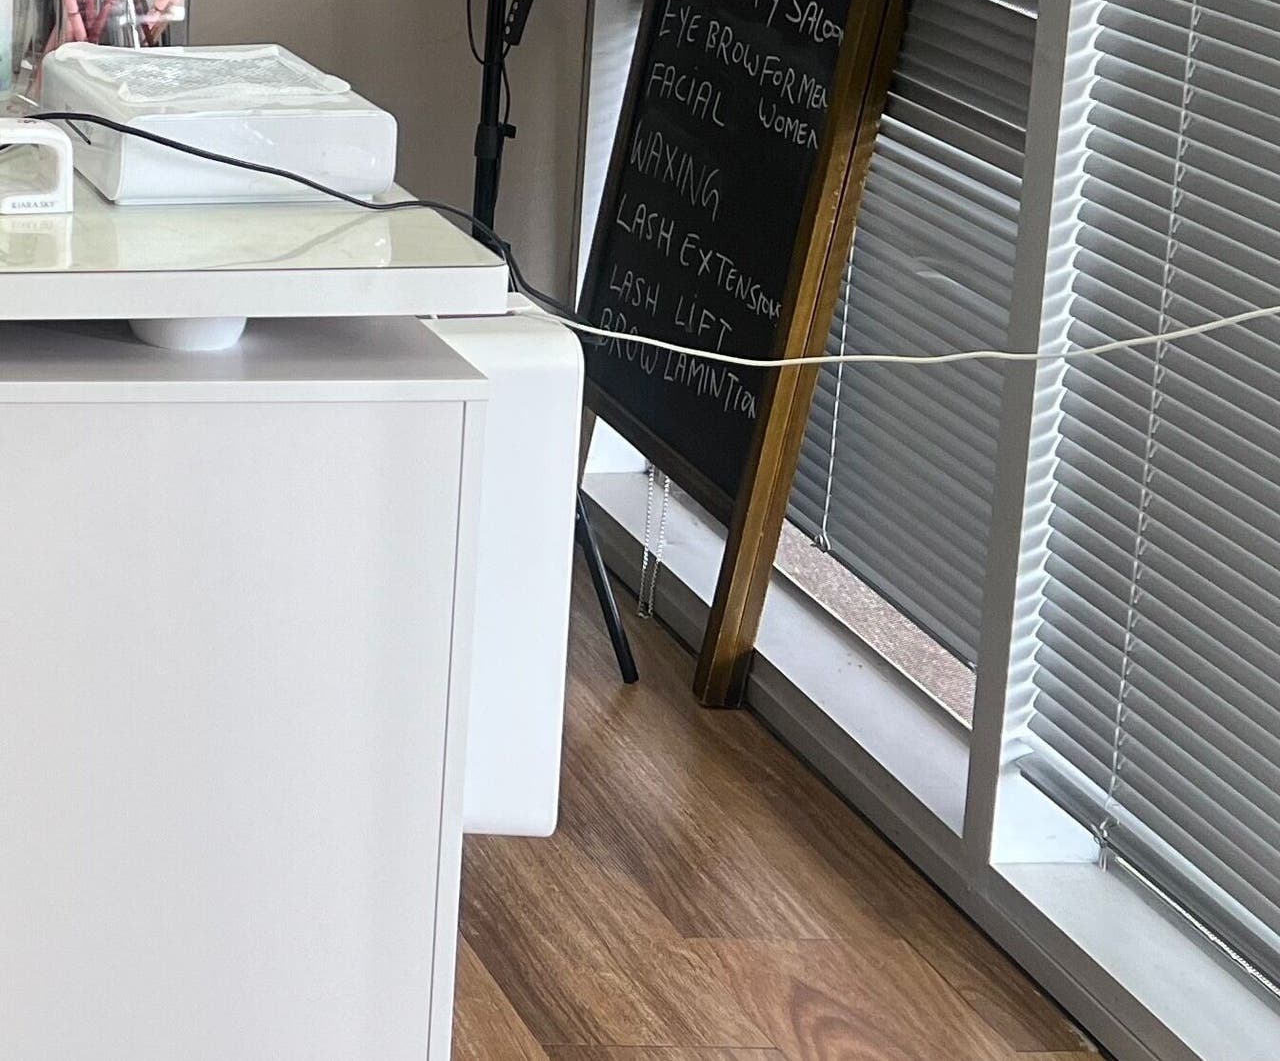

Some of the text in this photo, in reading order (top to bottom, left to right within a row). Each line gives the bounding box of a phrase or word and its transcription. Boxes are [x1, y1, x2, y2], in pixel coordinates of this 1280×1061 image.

[646, 61, 726, 128] FACIAL
[704, 20, 761, 78] BROW
[759, 54, 796, 106] FOR
[797, 73, 830, 110] MEN
[757, 96, 820, 151] WOMEN
[630, 121, 721, 224] WAXING
[615, 193, 676, 258] LASH
[609, 264, 661, 318] LASH
[596, 307, 661, 376] BROW
